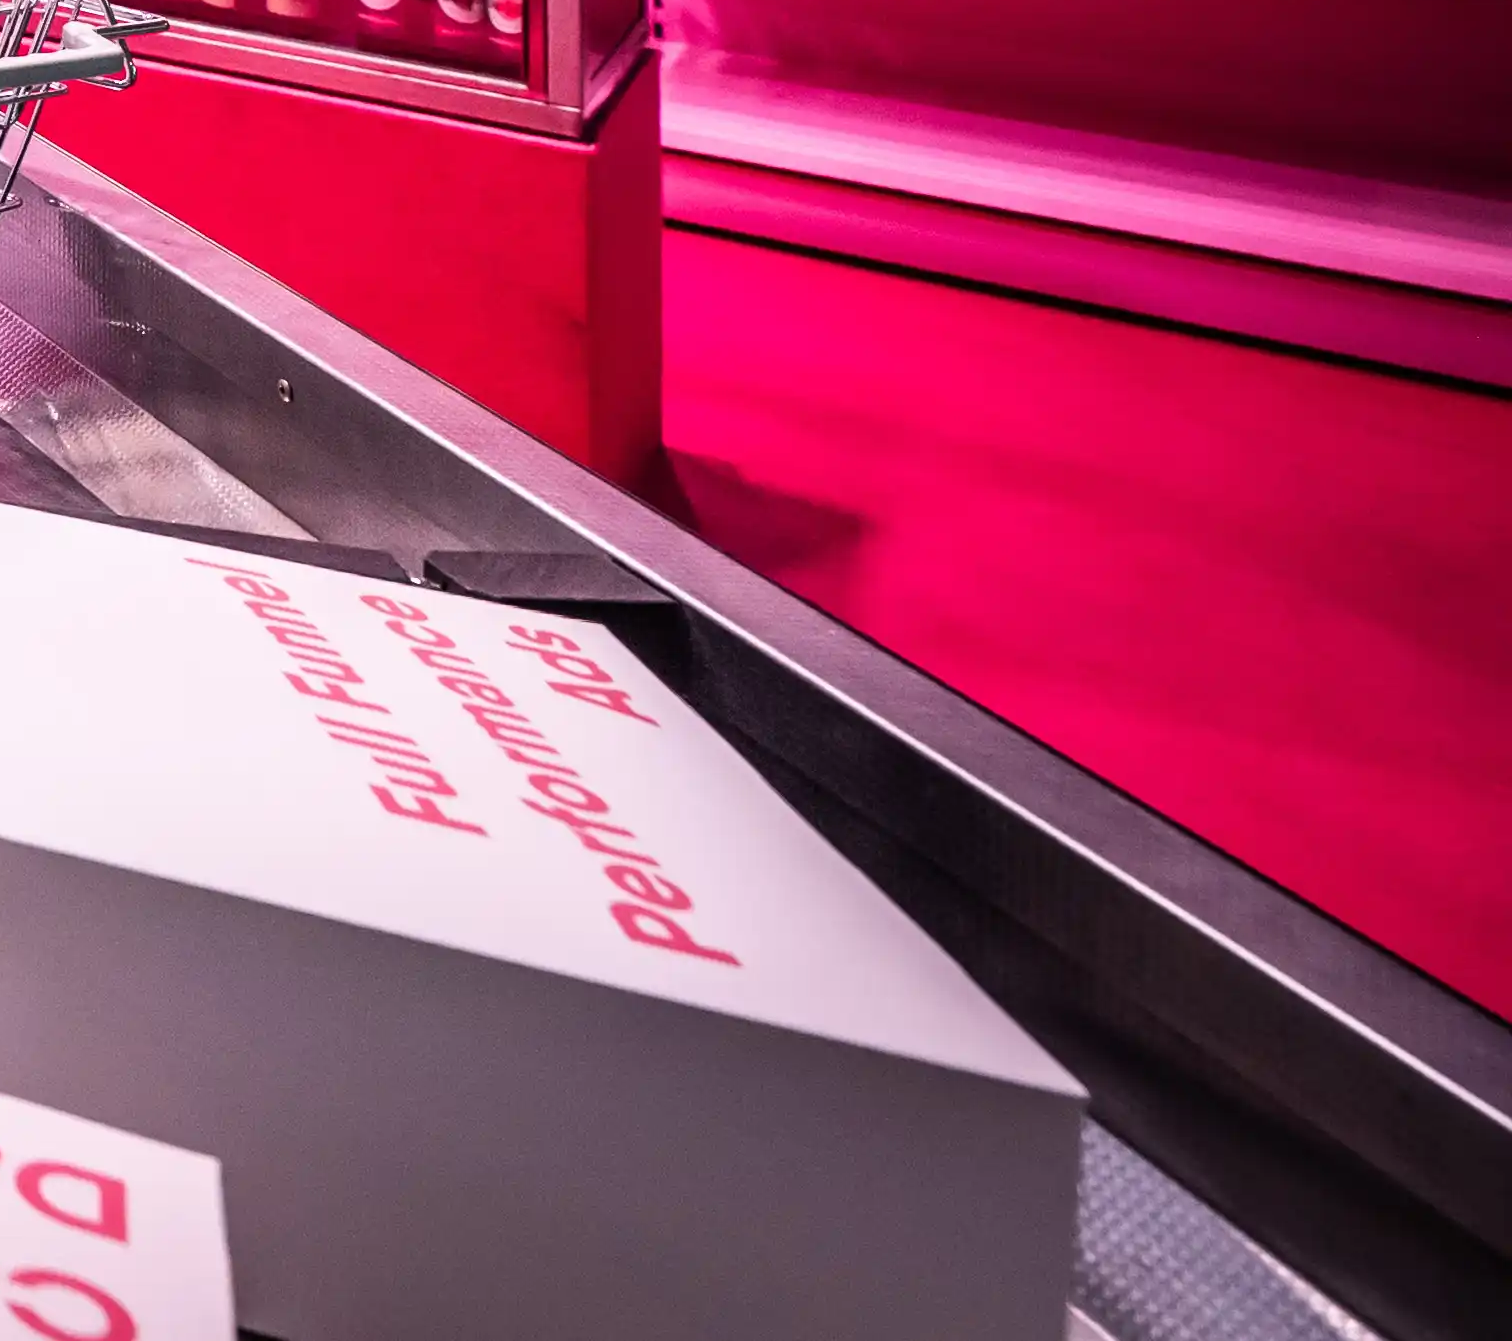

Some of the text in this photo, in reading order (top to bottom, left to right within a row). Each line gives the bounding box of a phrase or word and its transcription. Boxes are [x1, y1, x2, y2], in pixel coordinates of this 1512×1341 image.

[183, 556, 492, 839] Full Funnel
[358, 592, 744, 970] Performance
[506, 624, 661, 728] Ads
